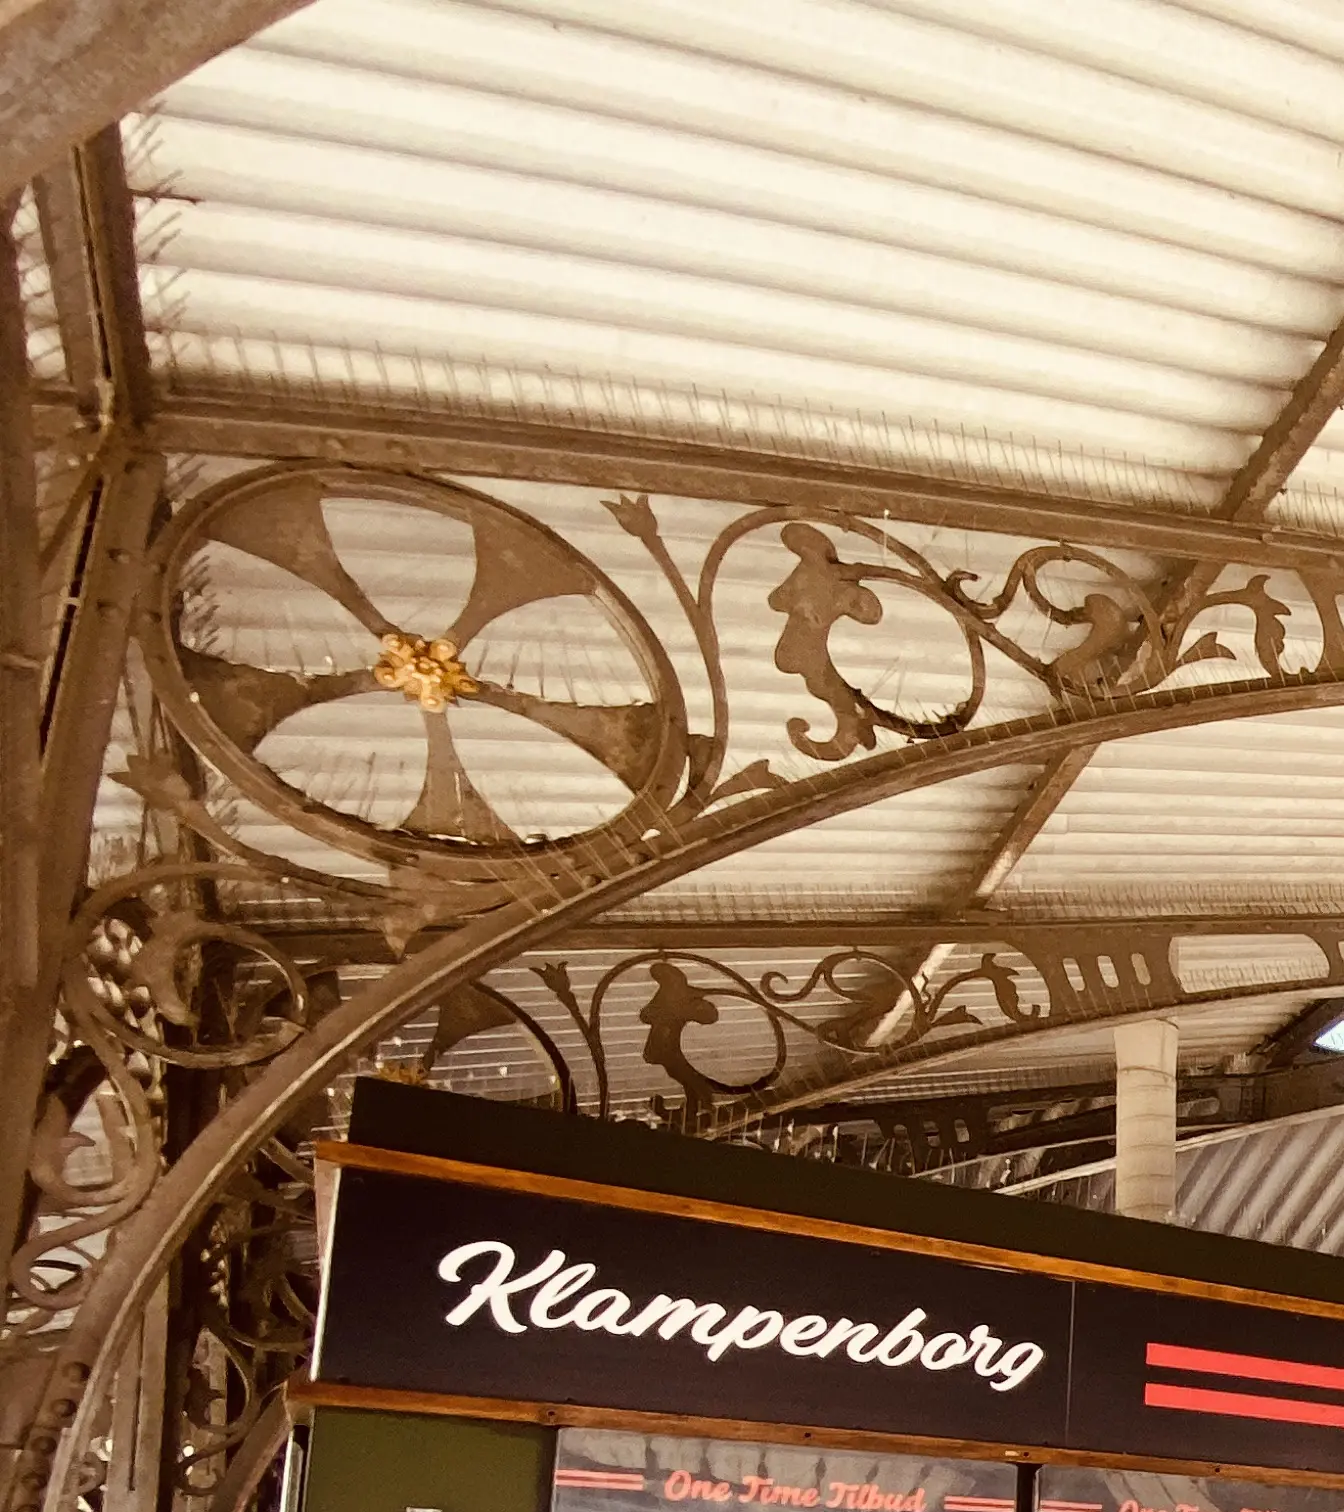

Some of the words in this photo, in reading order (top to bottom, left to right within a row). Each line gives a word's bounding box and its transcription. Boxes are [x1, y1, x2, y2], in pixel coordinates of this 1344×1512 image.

[438, 1241, 1046, 1391] Klampenborg
[664, 1470, 732, 1501] One
[738, 1475, 820, 1507] Time
[825, 1481, 927, 1512] Tilbud
